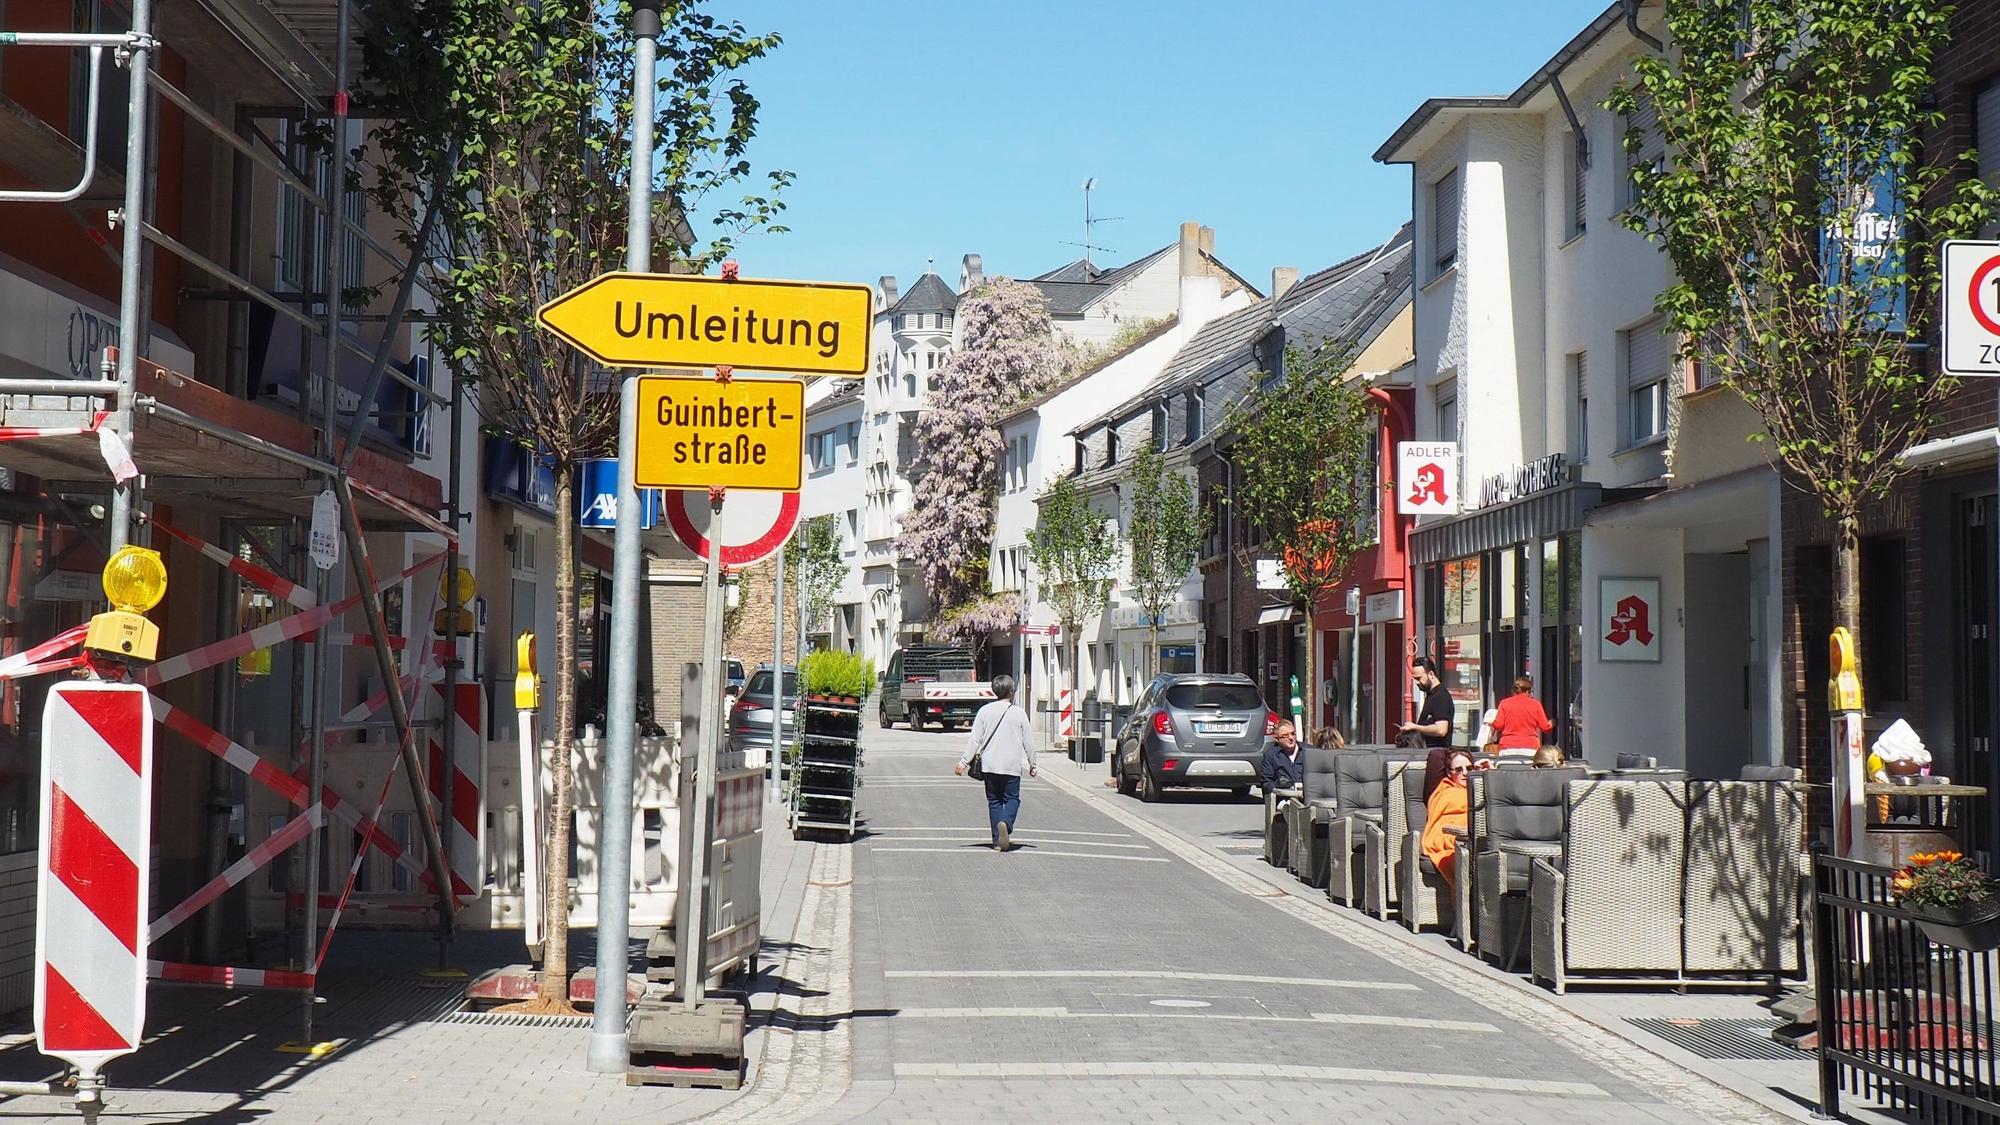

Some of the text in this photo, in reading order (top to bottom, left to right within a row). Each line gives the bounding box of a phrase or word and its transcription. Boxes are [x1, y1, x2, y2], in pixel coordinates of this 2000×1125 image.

[615, 300, 840, 358] Umleitung
[657, 395, 794, 428] Guinbert-
[673, 432, 767, 465] straße
[1406, 447, 1451, 458] ADLER
